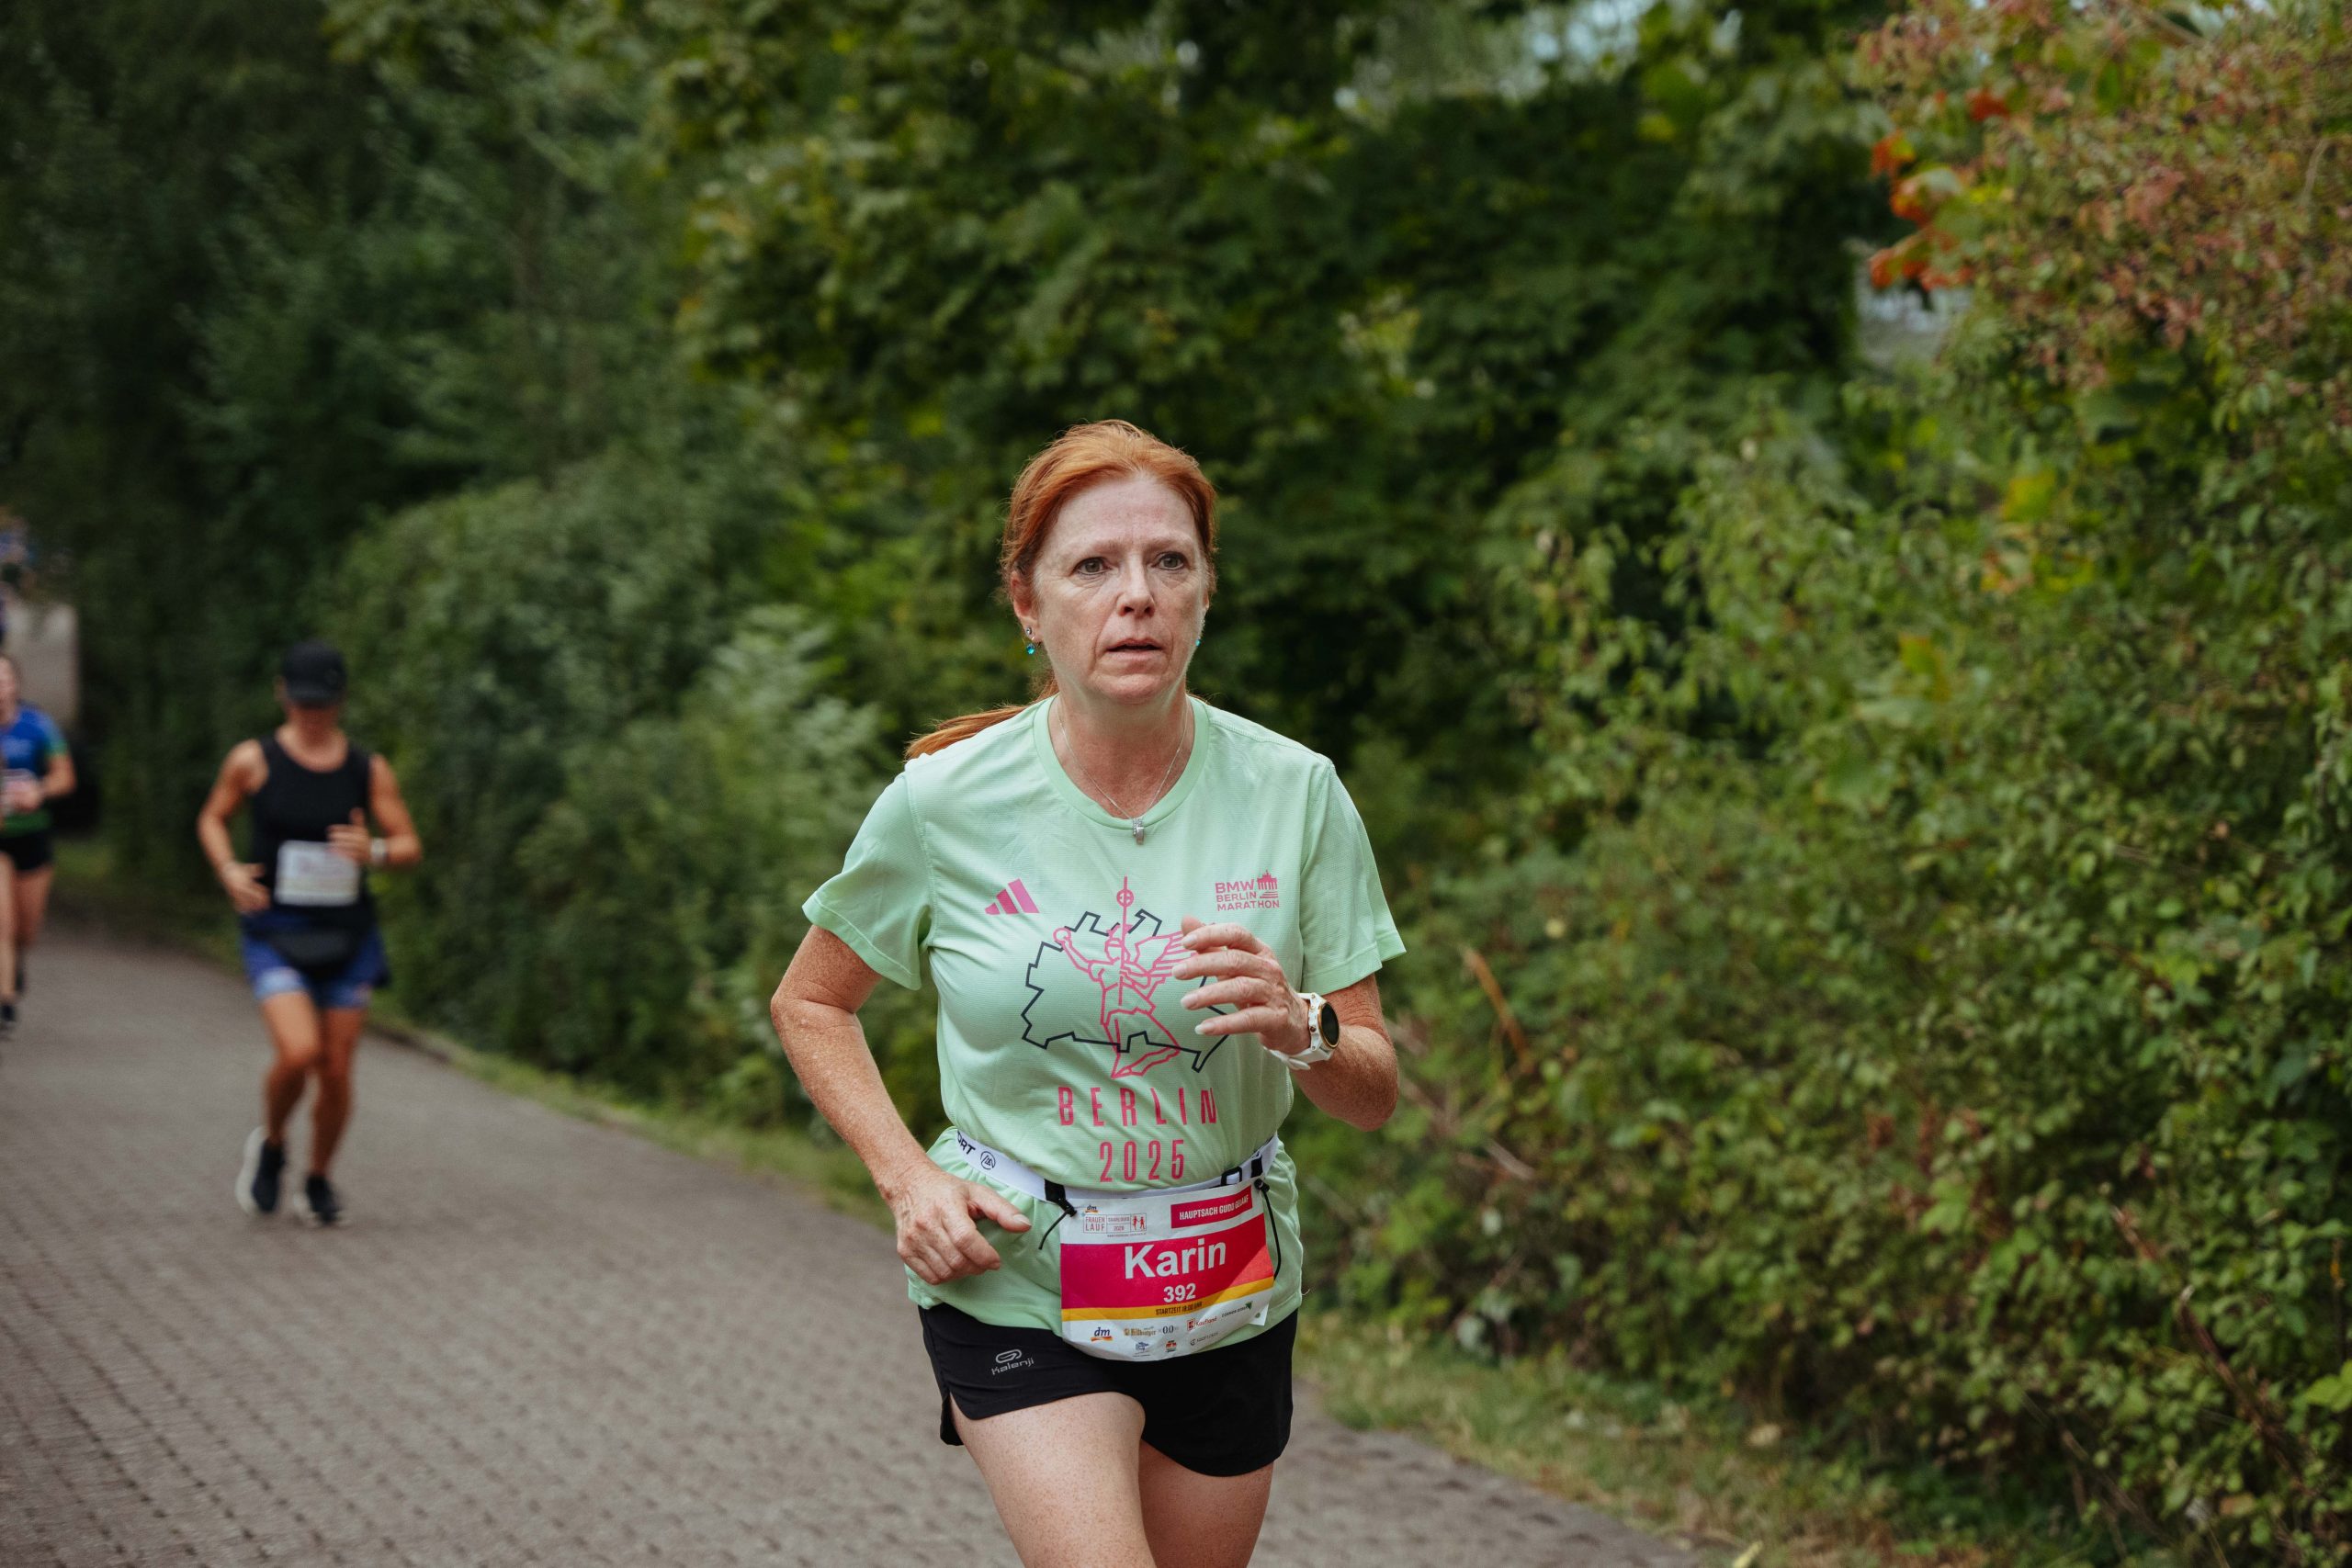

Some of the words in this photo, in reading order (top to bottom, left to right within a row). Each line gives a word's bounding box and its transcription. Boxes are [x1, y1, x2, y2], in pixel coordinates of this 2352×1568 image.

[1215, 879, 1255, 894] BMW
[1216, 891, 1258, 902] BERLIN
[1217, 900, 1280, 912] MARATHON
[1057, 1086, 1218, 1127] BERLIN
[1099, 1138, 1185, 1183] 2025
[1179, 1206, 1218, 1221] HAUPTSACH
[1085, 1224, 1105, 1232] LAUF
[1124, 1237, 1227, 1280] Karin
[1163, 1282, 1196, 1303] 392
[1156, 1306, 1182, 1315] STARTZEIT
[1093, 1326, 1111, 1337] dm
[990, 1357, 1035, 1376] Kalenji
